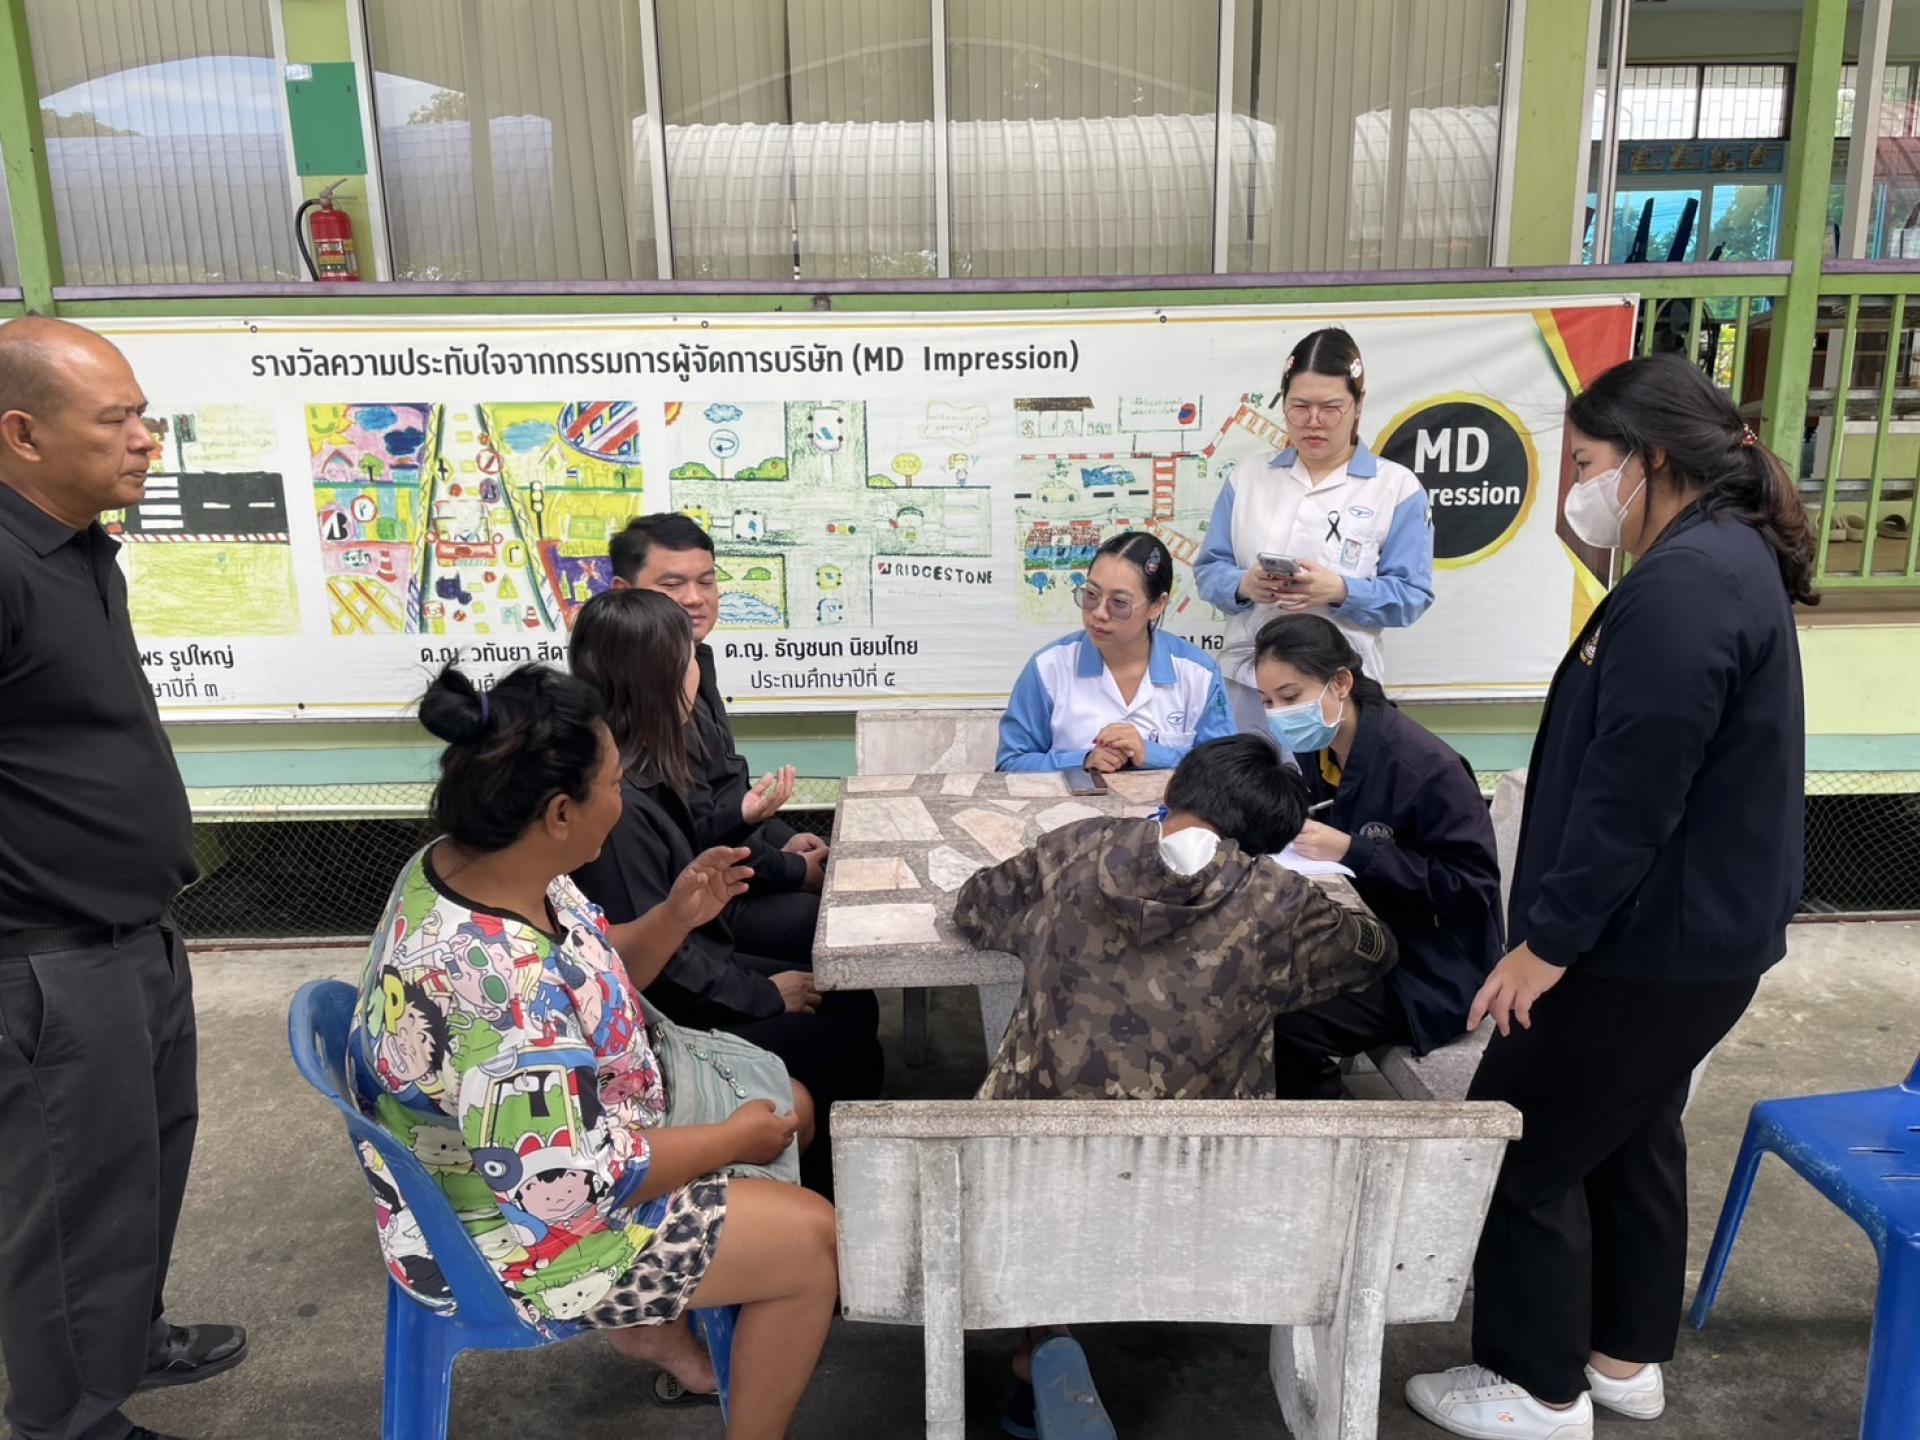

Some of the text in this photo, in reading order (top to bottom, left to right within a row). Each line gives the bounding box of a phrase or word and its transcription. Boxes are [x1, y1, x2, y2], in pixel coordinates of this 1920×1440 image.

[251, 339, 1079, 382] รางวัลความประทับใจจากกรรมการผู้จัดการบริษัท (MD Impression)
[1414, 426, 1490, 473] MD
[169, 643, 235, 672] รูปใหญ่
[470, 641, 531, 662] วทันยา
[725, 634, 919, 661] ด.ญ. ธัญชนก นิยมไทย
[750, 662, 878, 689] ประถมศึกษาปีที่
[204, 682, 219, 697] ๓
